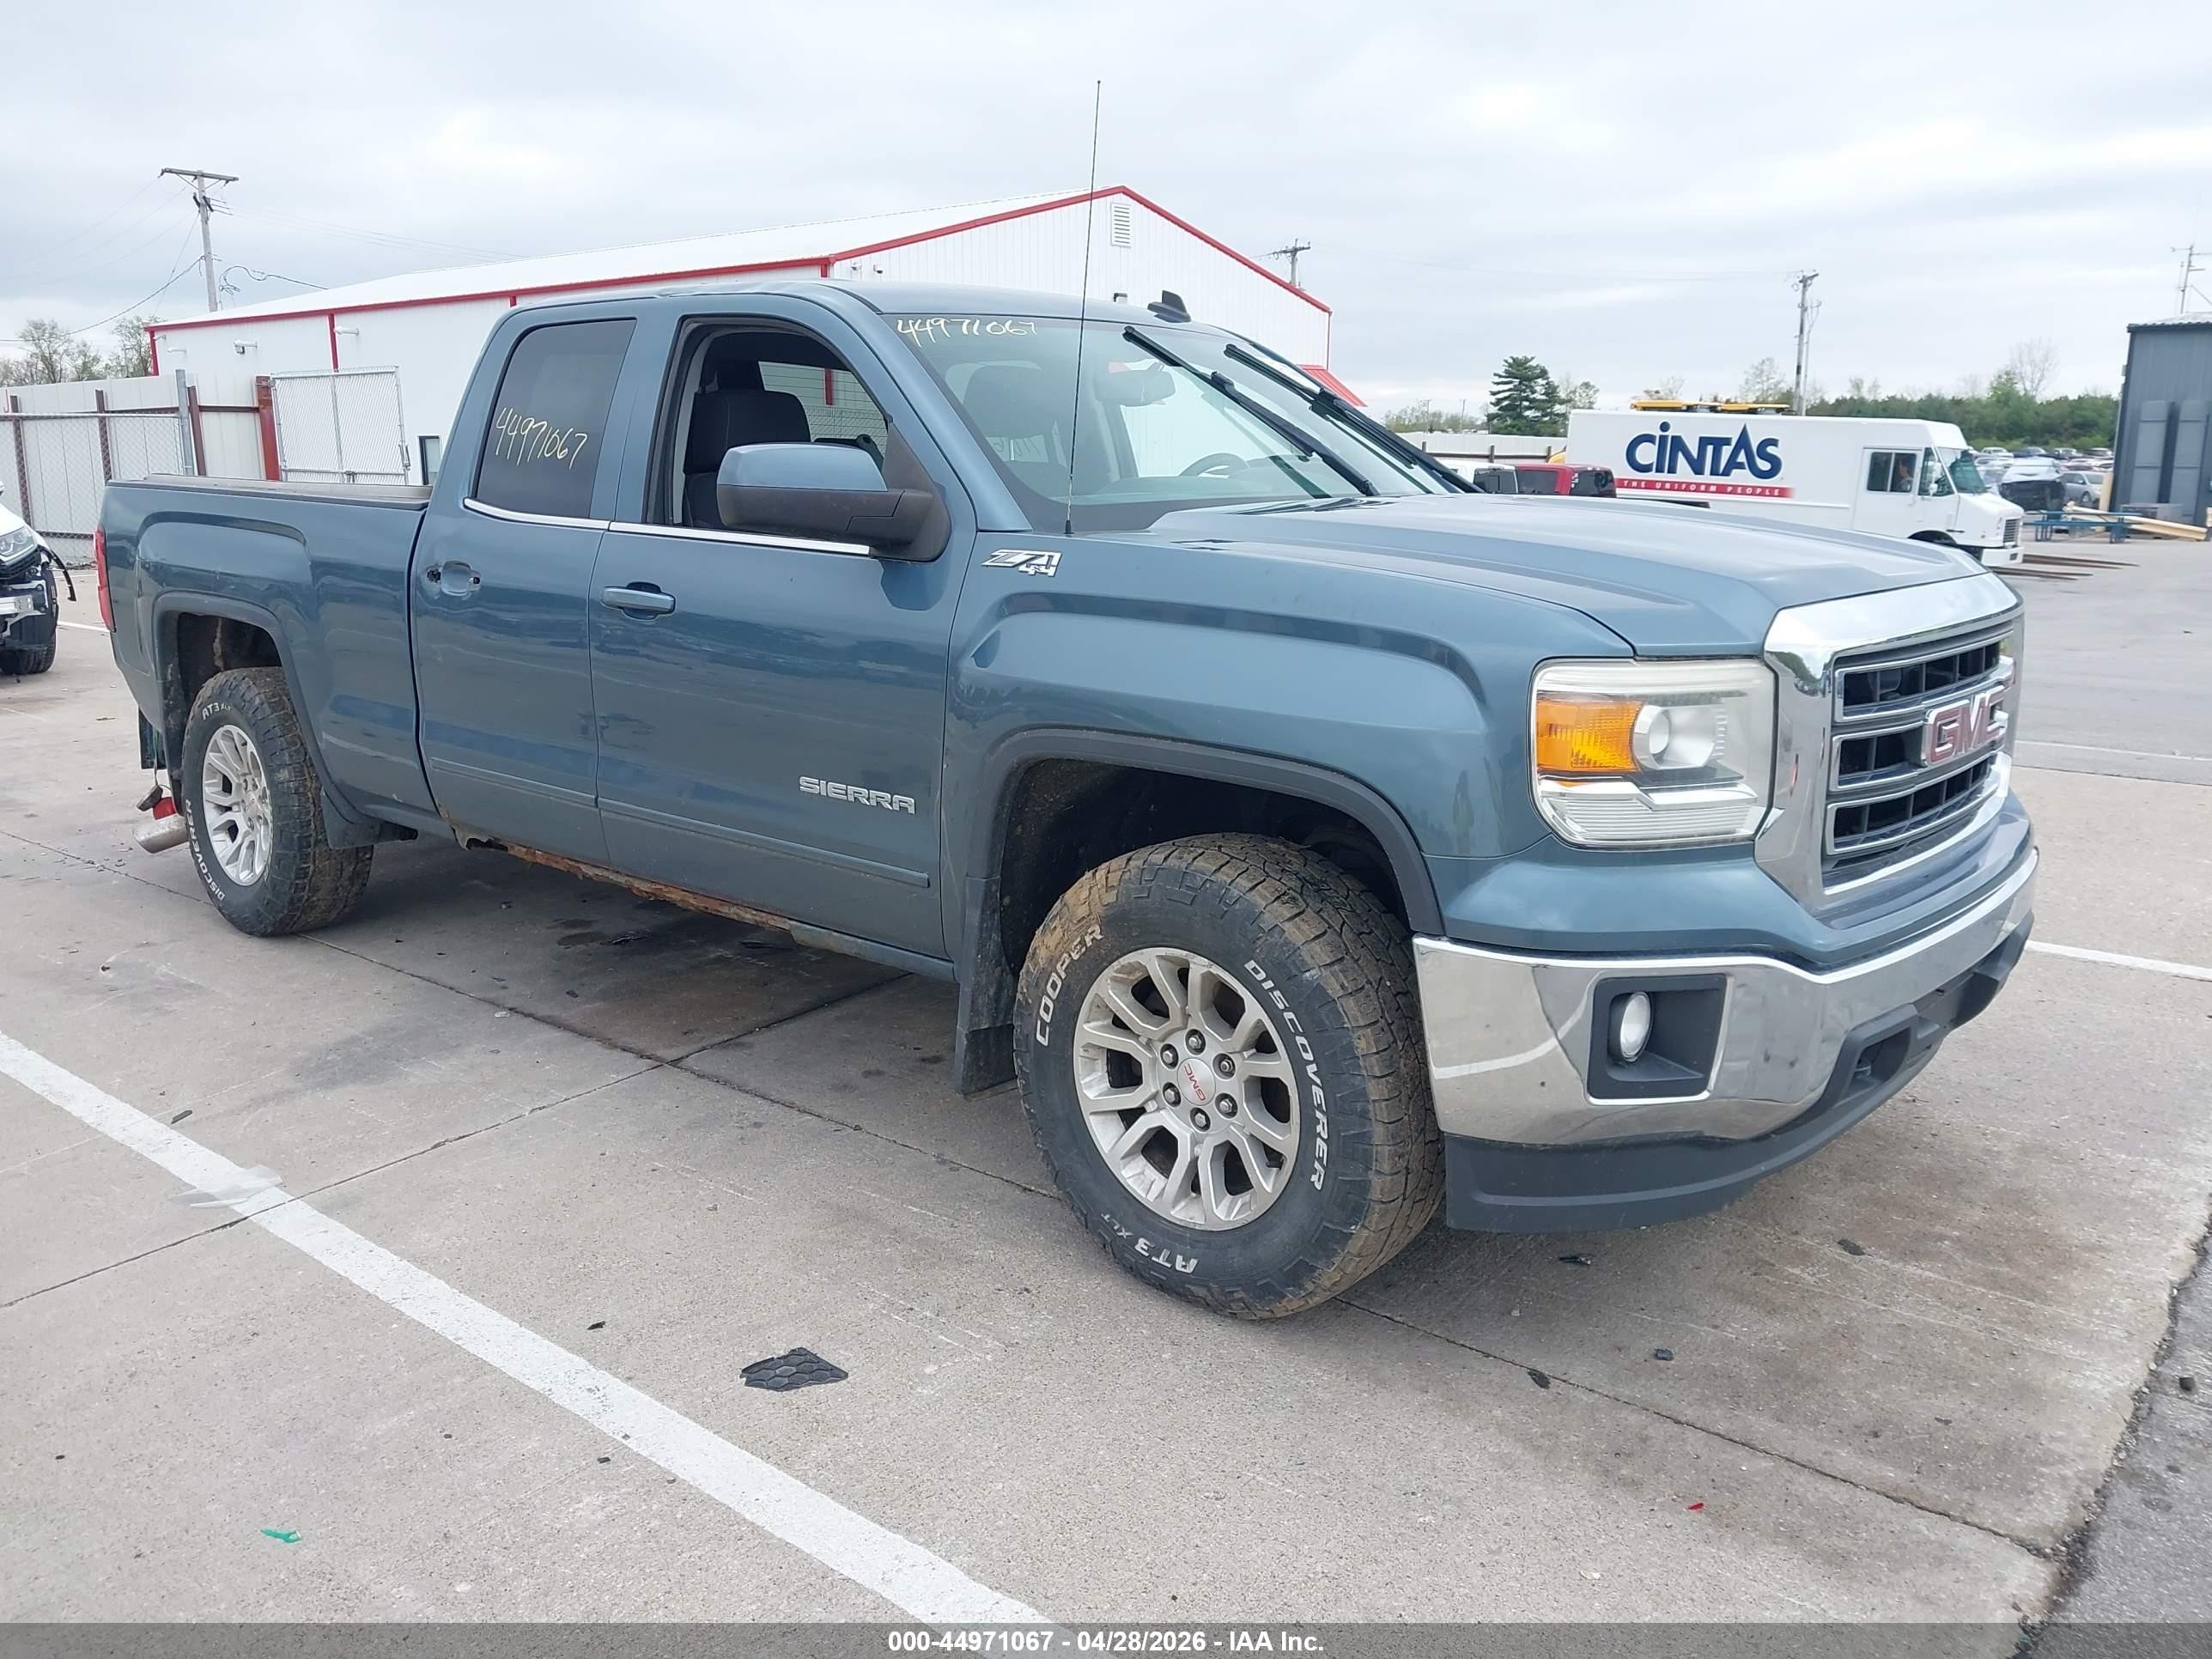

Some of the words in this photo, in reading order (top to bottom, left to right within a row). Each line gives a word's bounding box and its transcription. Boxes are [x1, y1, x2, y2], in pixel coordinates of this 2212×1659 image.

[896, 317, 1037, 348] 44971067
[495, 406, 588, 471] 44971067
[1623, 480, 1646, 489] THE
[1656, 482, 1717, 492] UNIFORM
[1727, 486, 1780, 496] PEOPLE
[1924, 685, 2008, 763] GMC
[799, 775, 916, 815] SIERRA
[185, 799, 226, 901] DISCOVERER
[1036, 924, 1105, 1047] COOPER
[1183, 1062, 1206, 1101] GMC
[1244, 959, 1328, 1191] DISCOVERER
[1100, 1212, 1134, 1239] XLT
[1133, 1237, 1200, 1274] AT3
